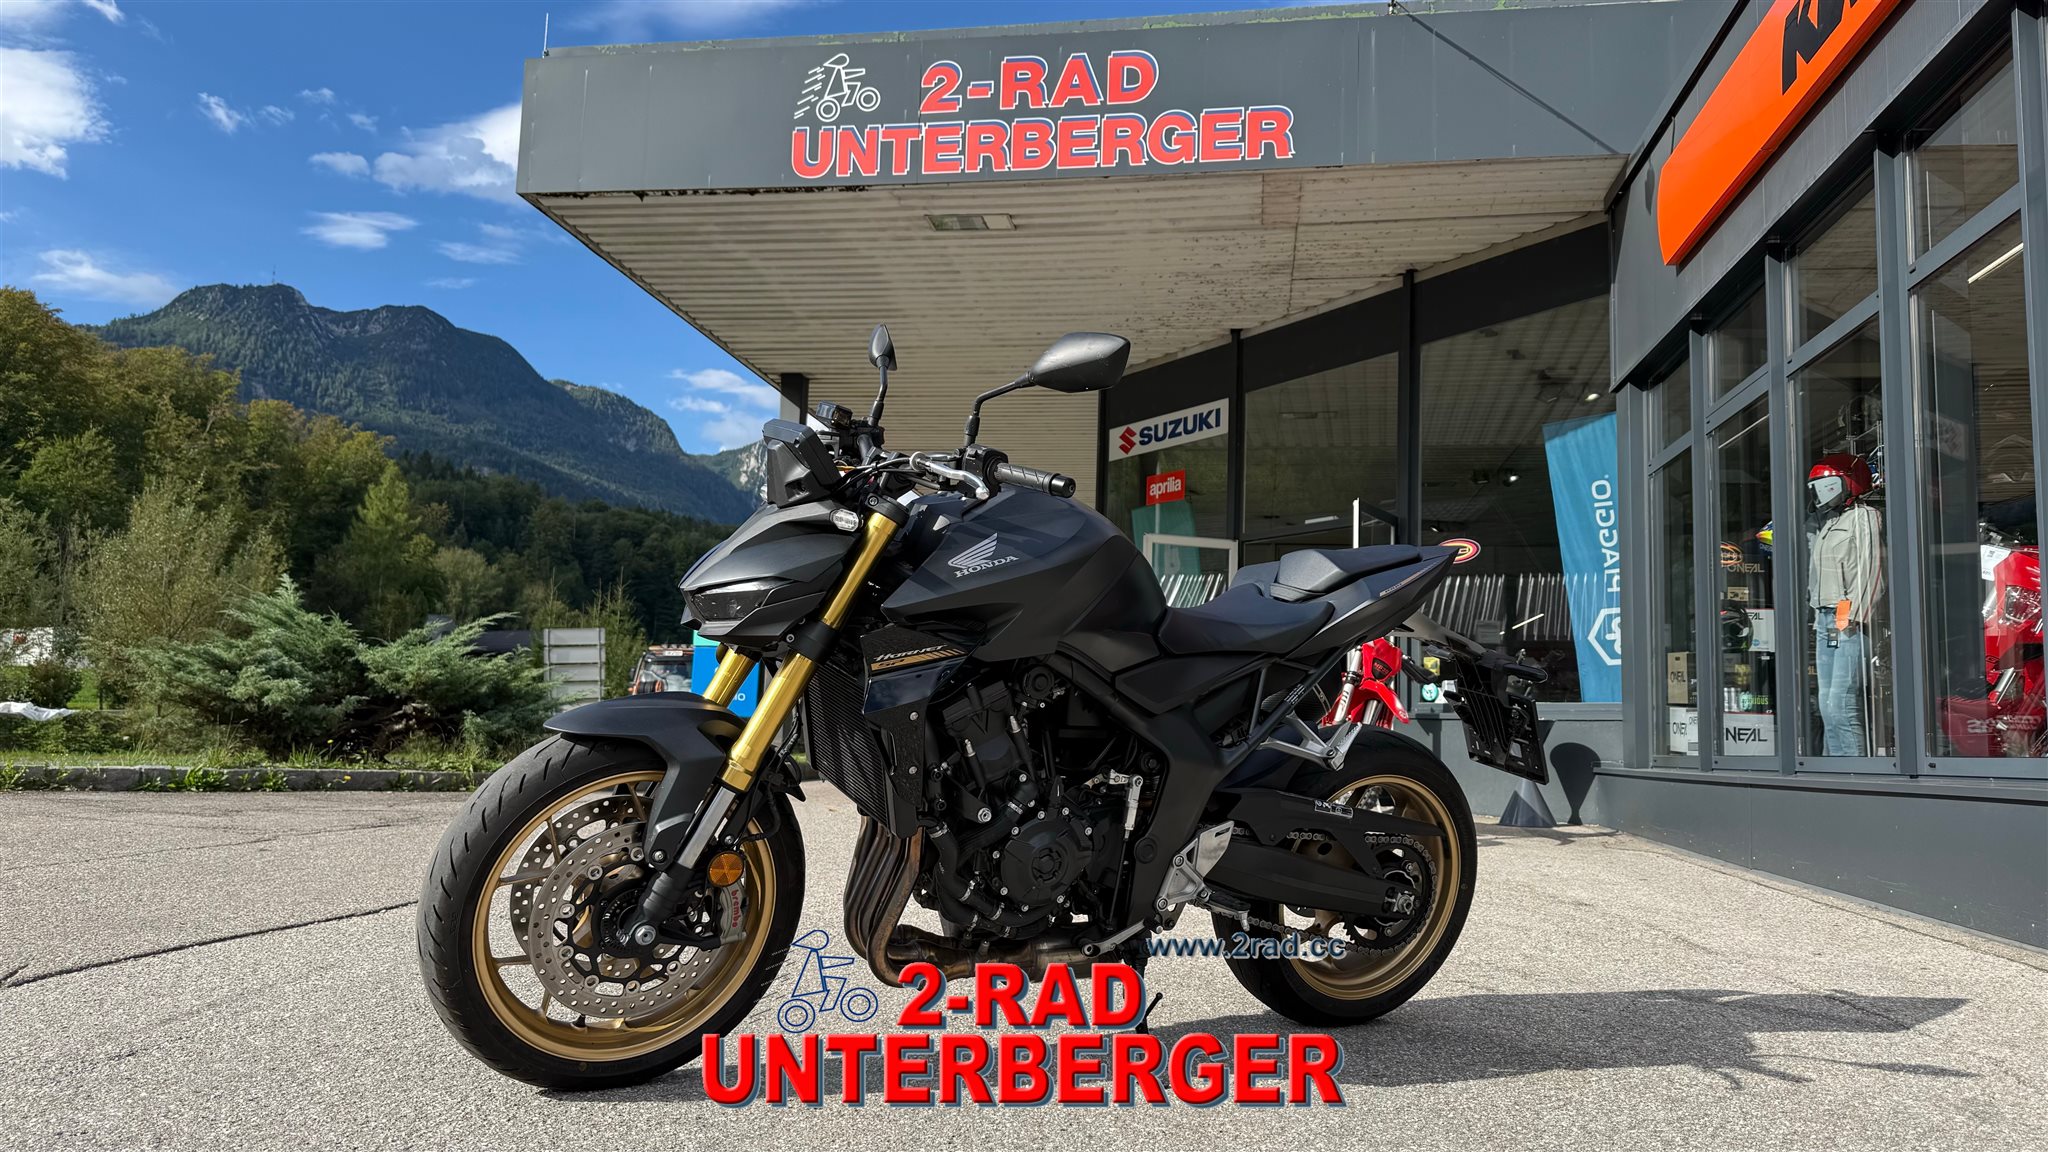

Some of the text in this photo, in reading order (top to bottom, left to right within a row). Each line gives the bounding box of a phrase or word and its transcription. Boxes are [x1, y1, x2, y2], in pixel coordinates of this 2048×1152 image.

[920, 49, 1160, 114] 2-RAD
[790, 104, 1296, 180] UNTERBERGER
[1138, 407, 1221, 446] SUZUKI
[1149, 476, 1182, 499] aprilia
[953, 555, 1020, 578] HONDA
[1725, 726, 1768, 745] NEAL
[731, 889, 742, 929] brembo
